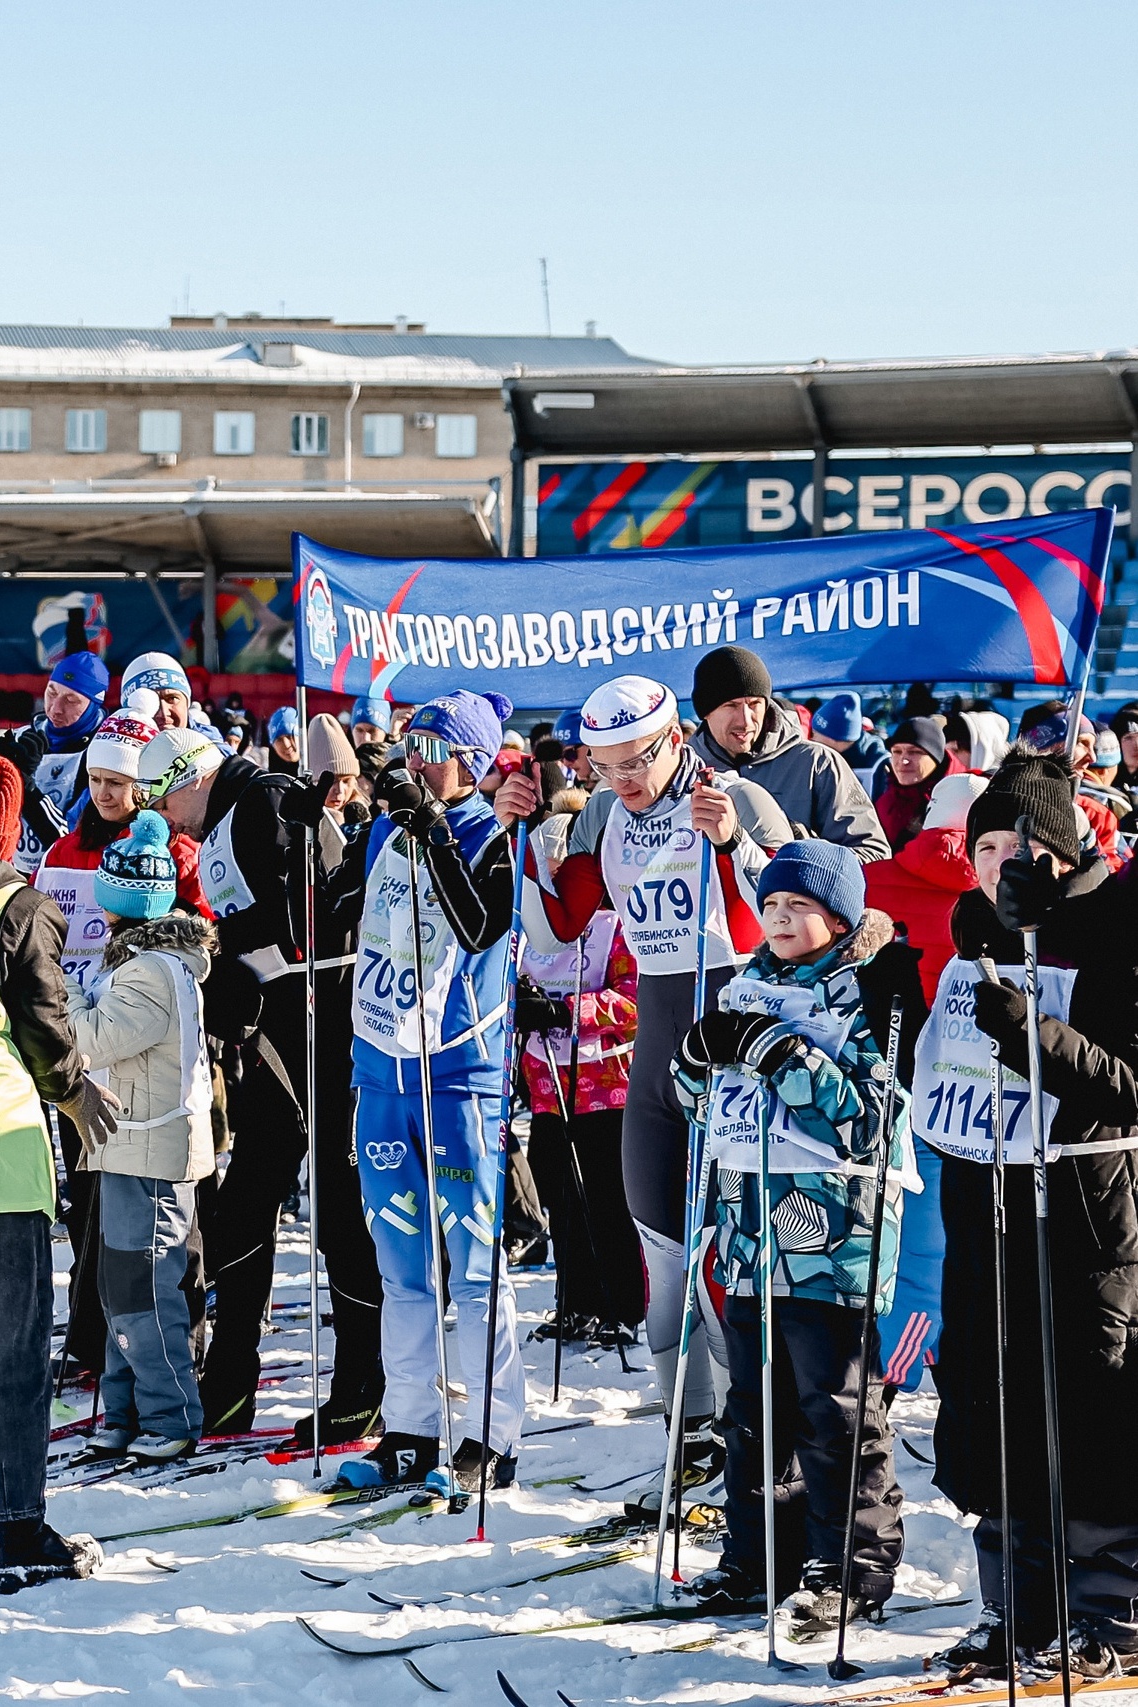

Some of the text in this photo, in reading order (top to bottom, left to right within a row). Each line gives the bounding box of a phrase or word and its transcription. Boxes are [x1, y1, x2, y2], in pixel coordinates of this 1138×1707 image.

[343, 571, 920, 670] ТРАКТОРОЗАВОДСКИЙ РАЙОН
[638, 942, 679, 956] ОБЛАСТЬ
[358, 947, 417, 1010] 709
[363, 1015, 396, 1038] ОБЛАСТЬ
[887, 1031, 900, 1087] NORDWAY
[926, 1080, 1032, 1142] 11147
[330, 1408, 373, 1425] FISCHER
